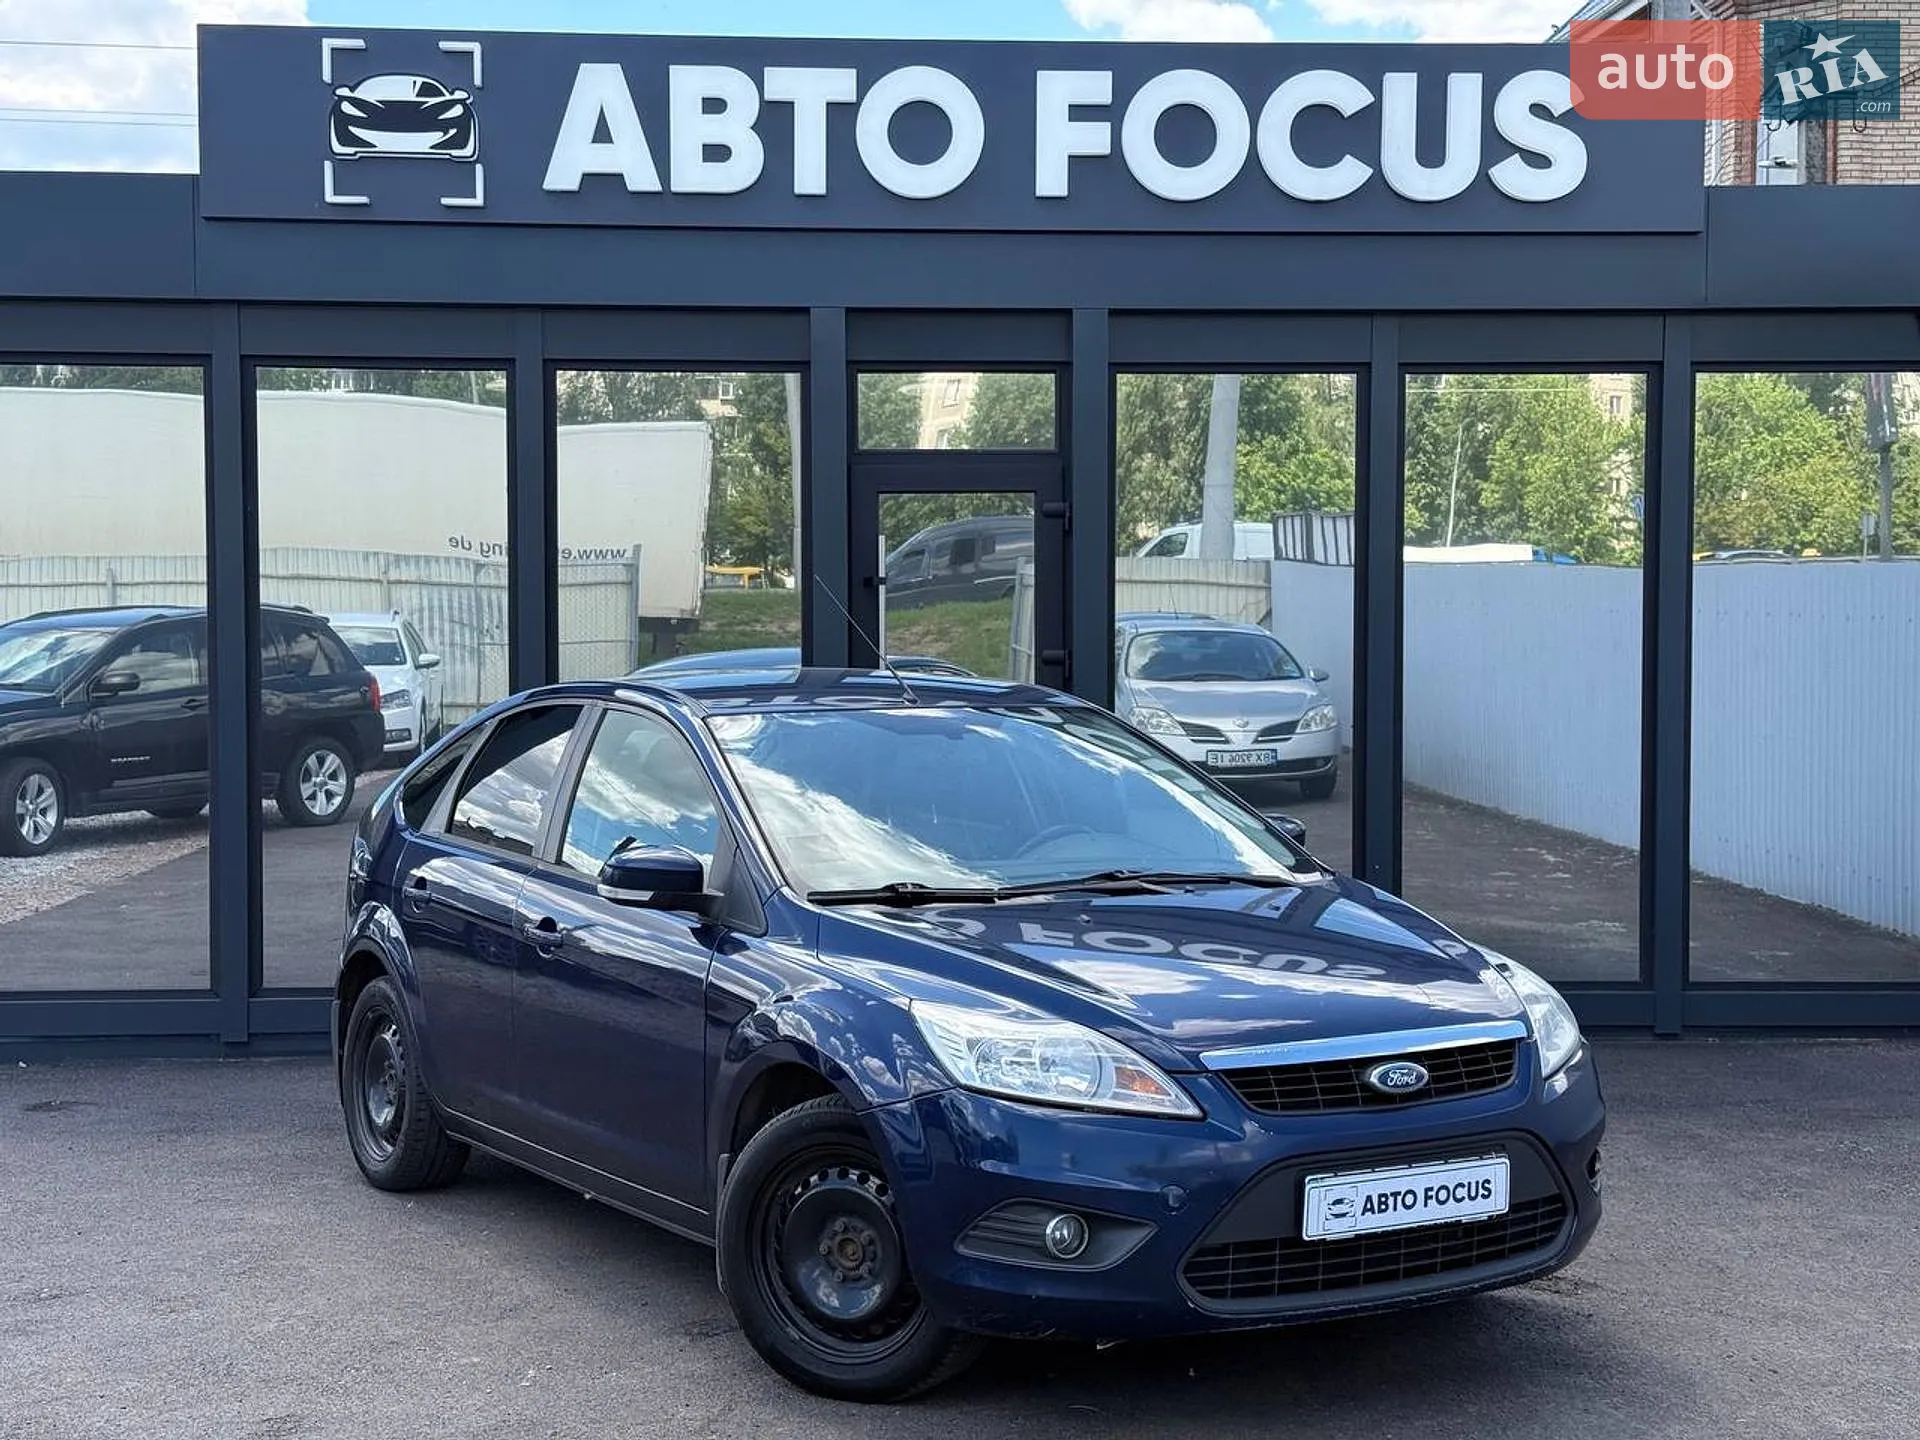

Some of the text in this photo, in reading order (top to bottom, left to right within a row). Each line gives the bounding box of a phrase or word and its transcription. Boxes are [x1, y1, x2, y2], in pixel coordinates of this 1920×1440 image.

[541, 61, 1589, 202] АВТО FOCUS
[1387, 1069, 1417, 1086] Ford
[1361, 1179, 1492, 1216] АВТО FOCUS
